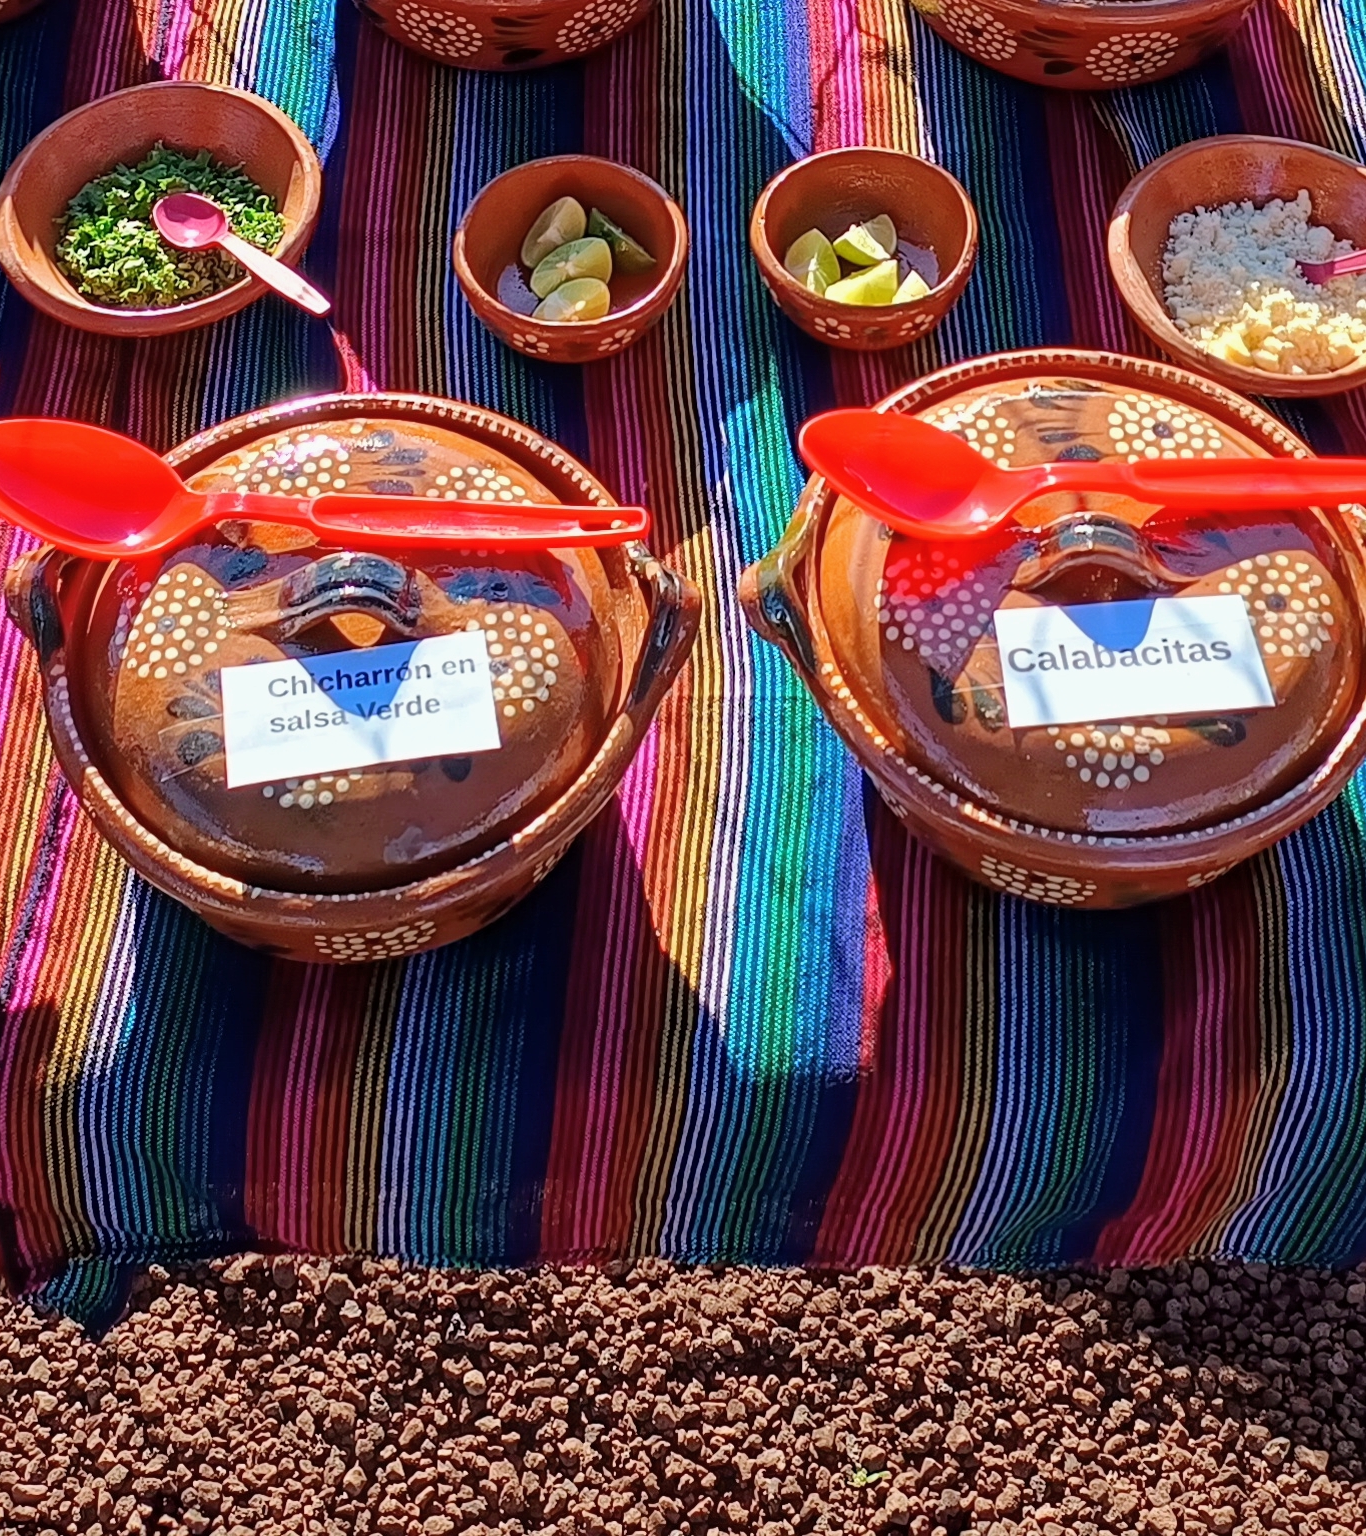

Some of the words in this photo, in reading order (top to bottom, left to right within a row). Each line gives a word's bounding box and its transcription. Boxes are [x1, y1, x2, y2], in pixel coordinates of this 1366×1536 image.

[1007, 638, 1232, 673] Calabacitas
[268, 660, 432, 699] Chicharrón
[442, 657, 476, 677] en
[270, 706, 349, 734] salsa
[356, 694, 441, 722] Verde
